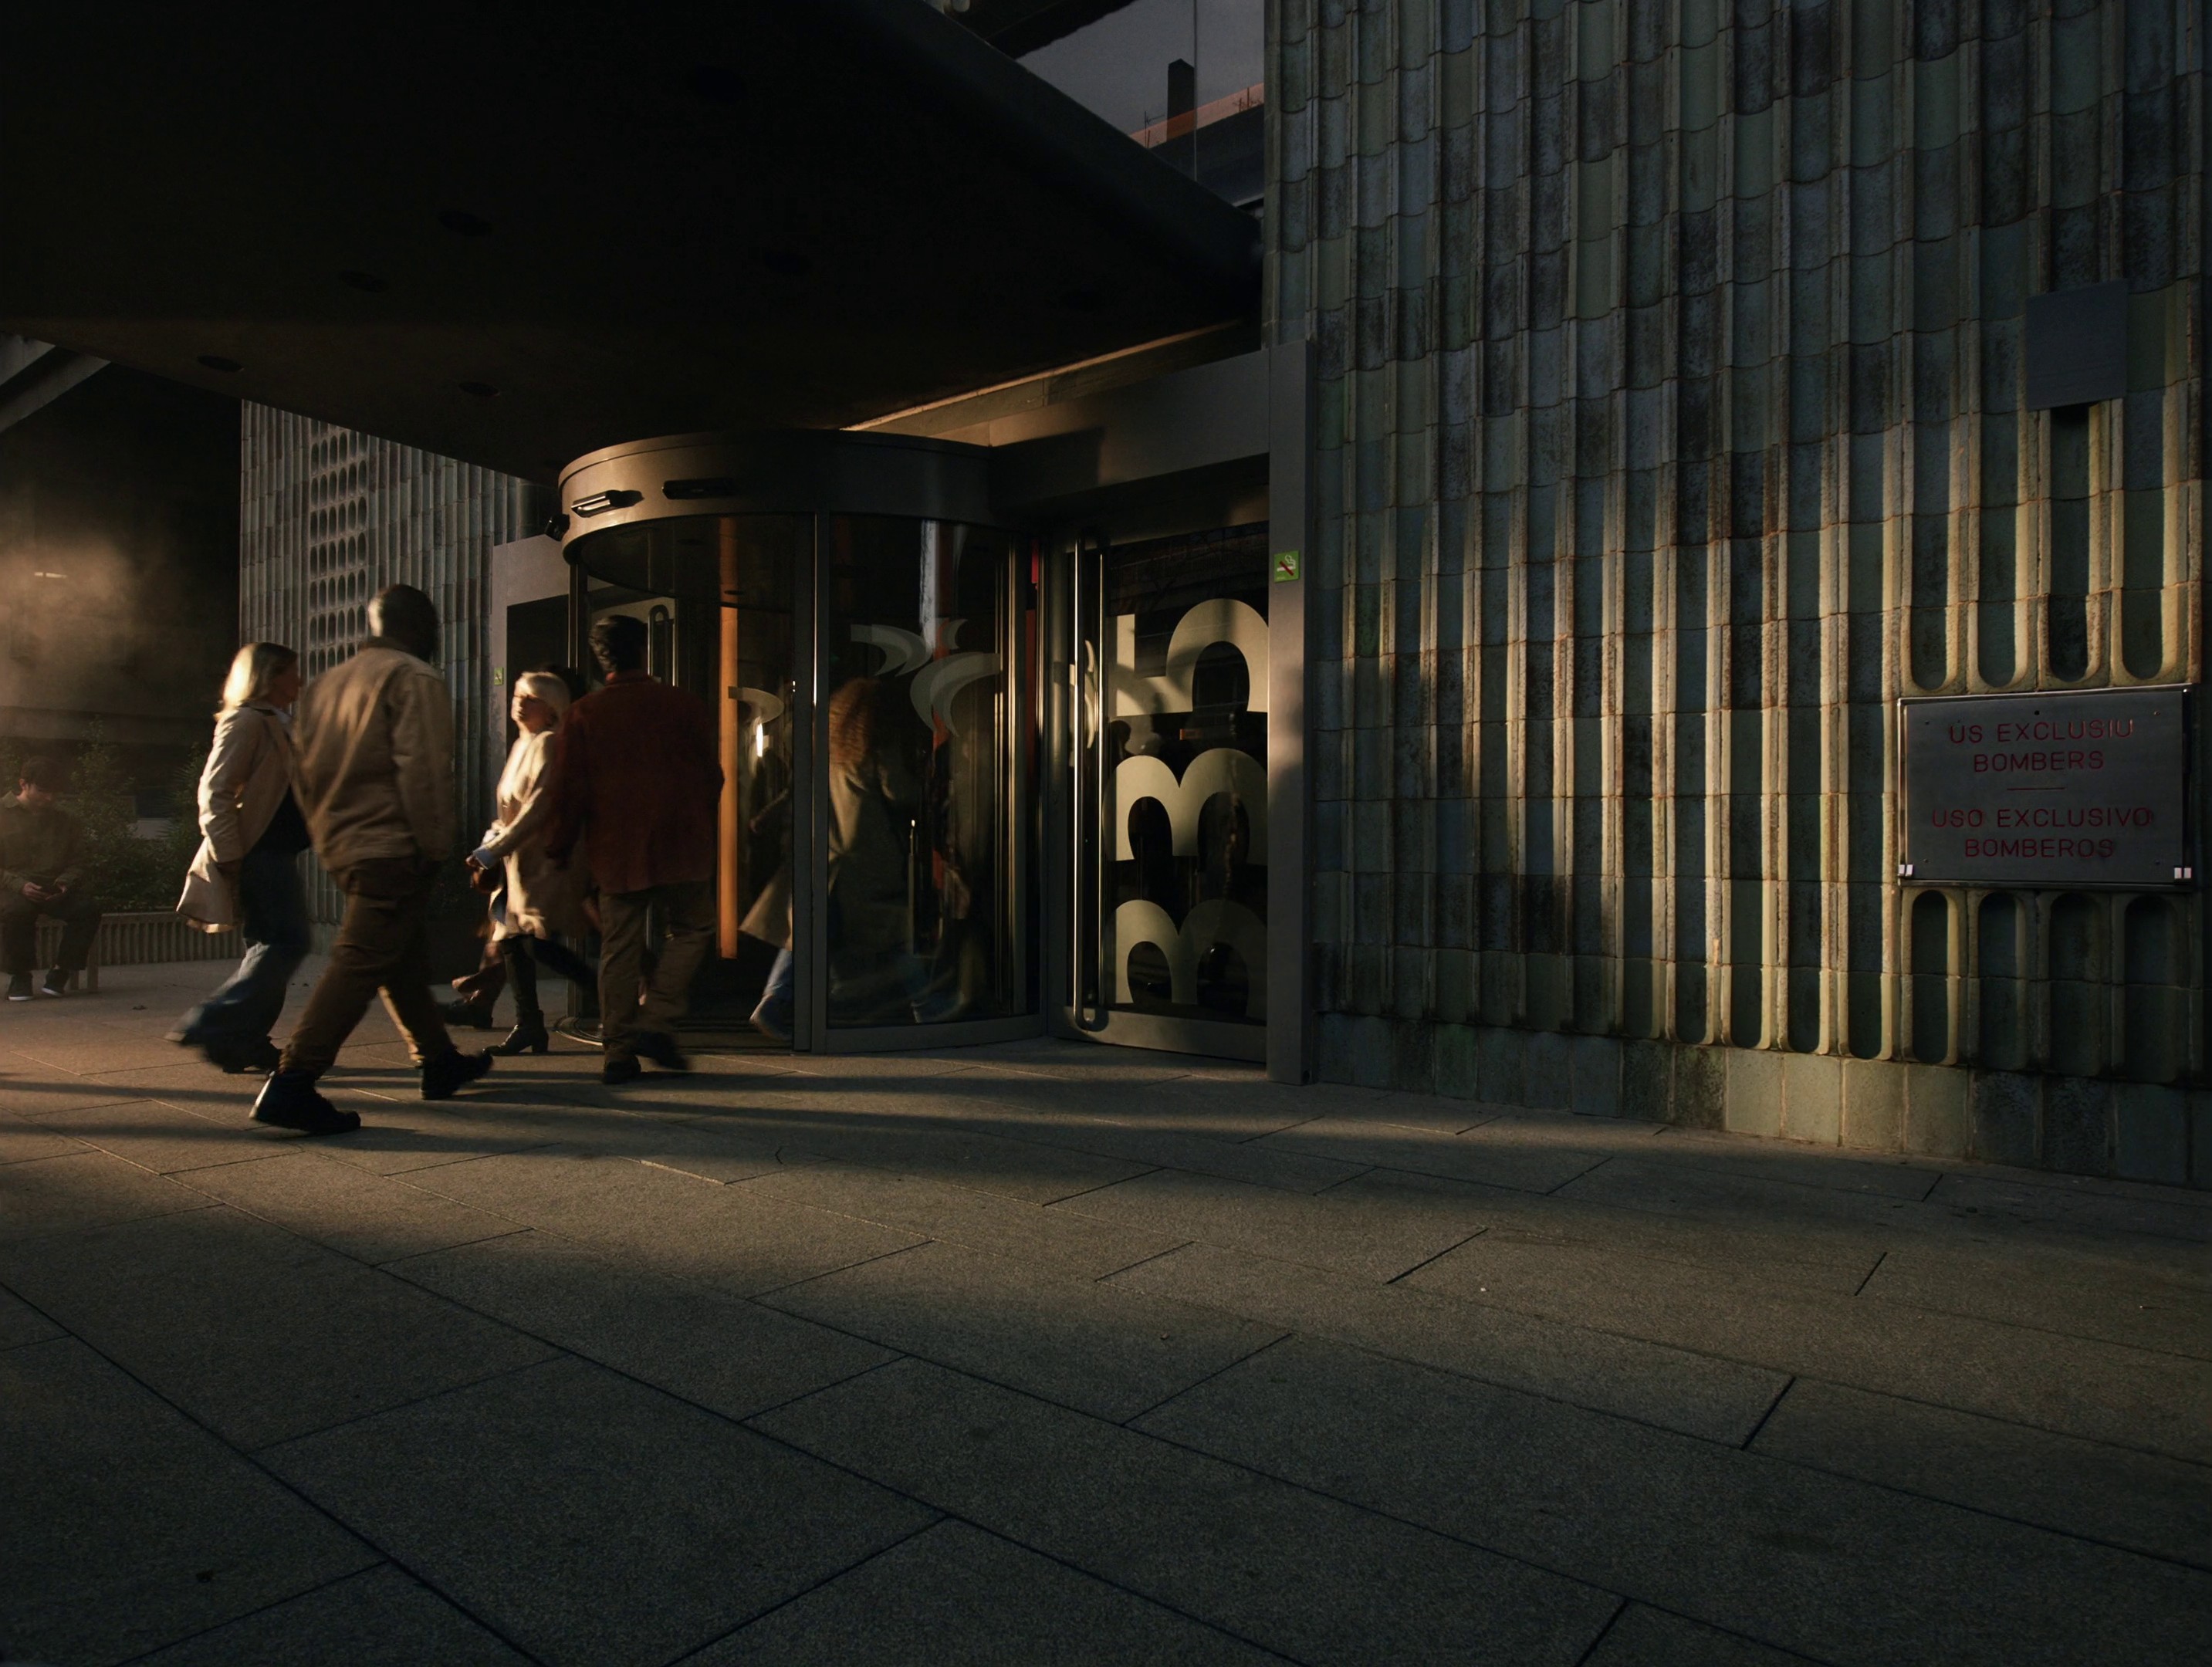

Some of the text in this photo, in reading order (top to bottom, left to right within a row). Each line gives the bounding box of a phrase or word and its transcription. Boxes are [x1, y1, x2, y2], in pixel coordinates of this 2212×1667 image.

[1997, 719, 2134, 742] EXCLUSIU
[1974, 750, 2105, 773] BOMBERS
[1932, 807, 2153, 829] USO EXCLUSIVO
[1965, 838, 2114, 858] BOMBEROS
